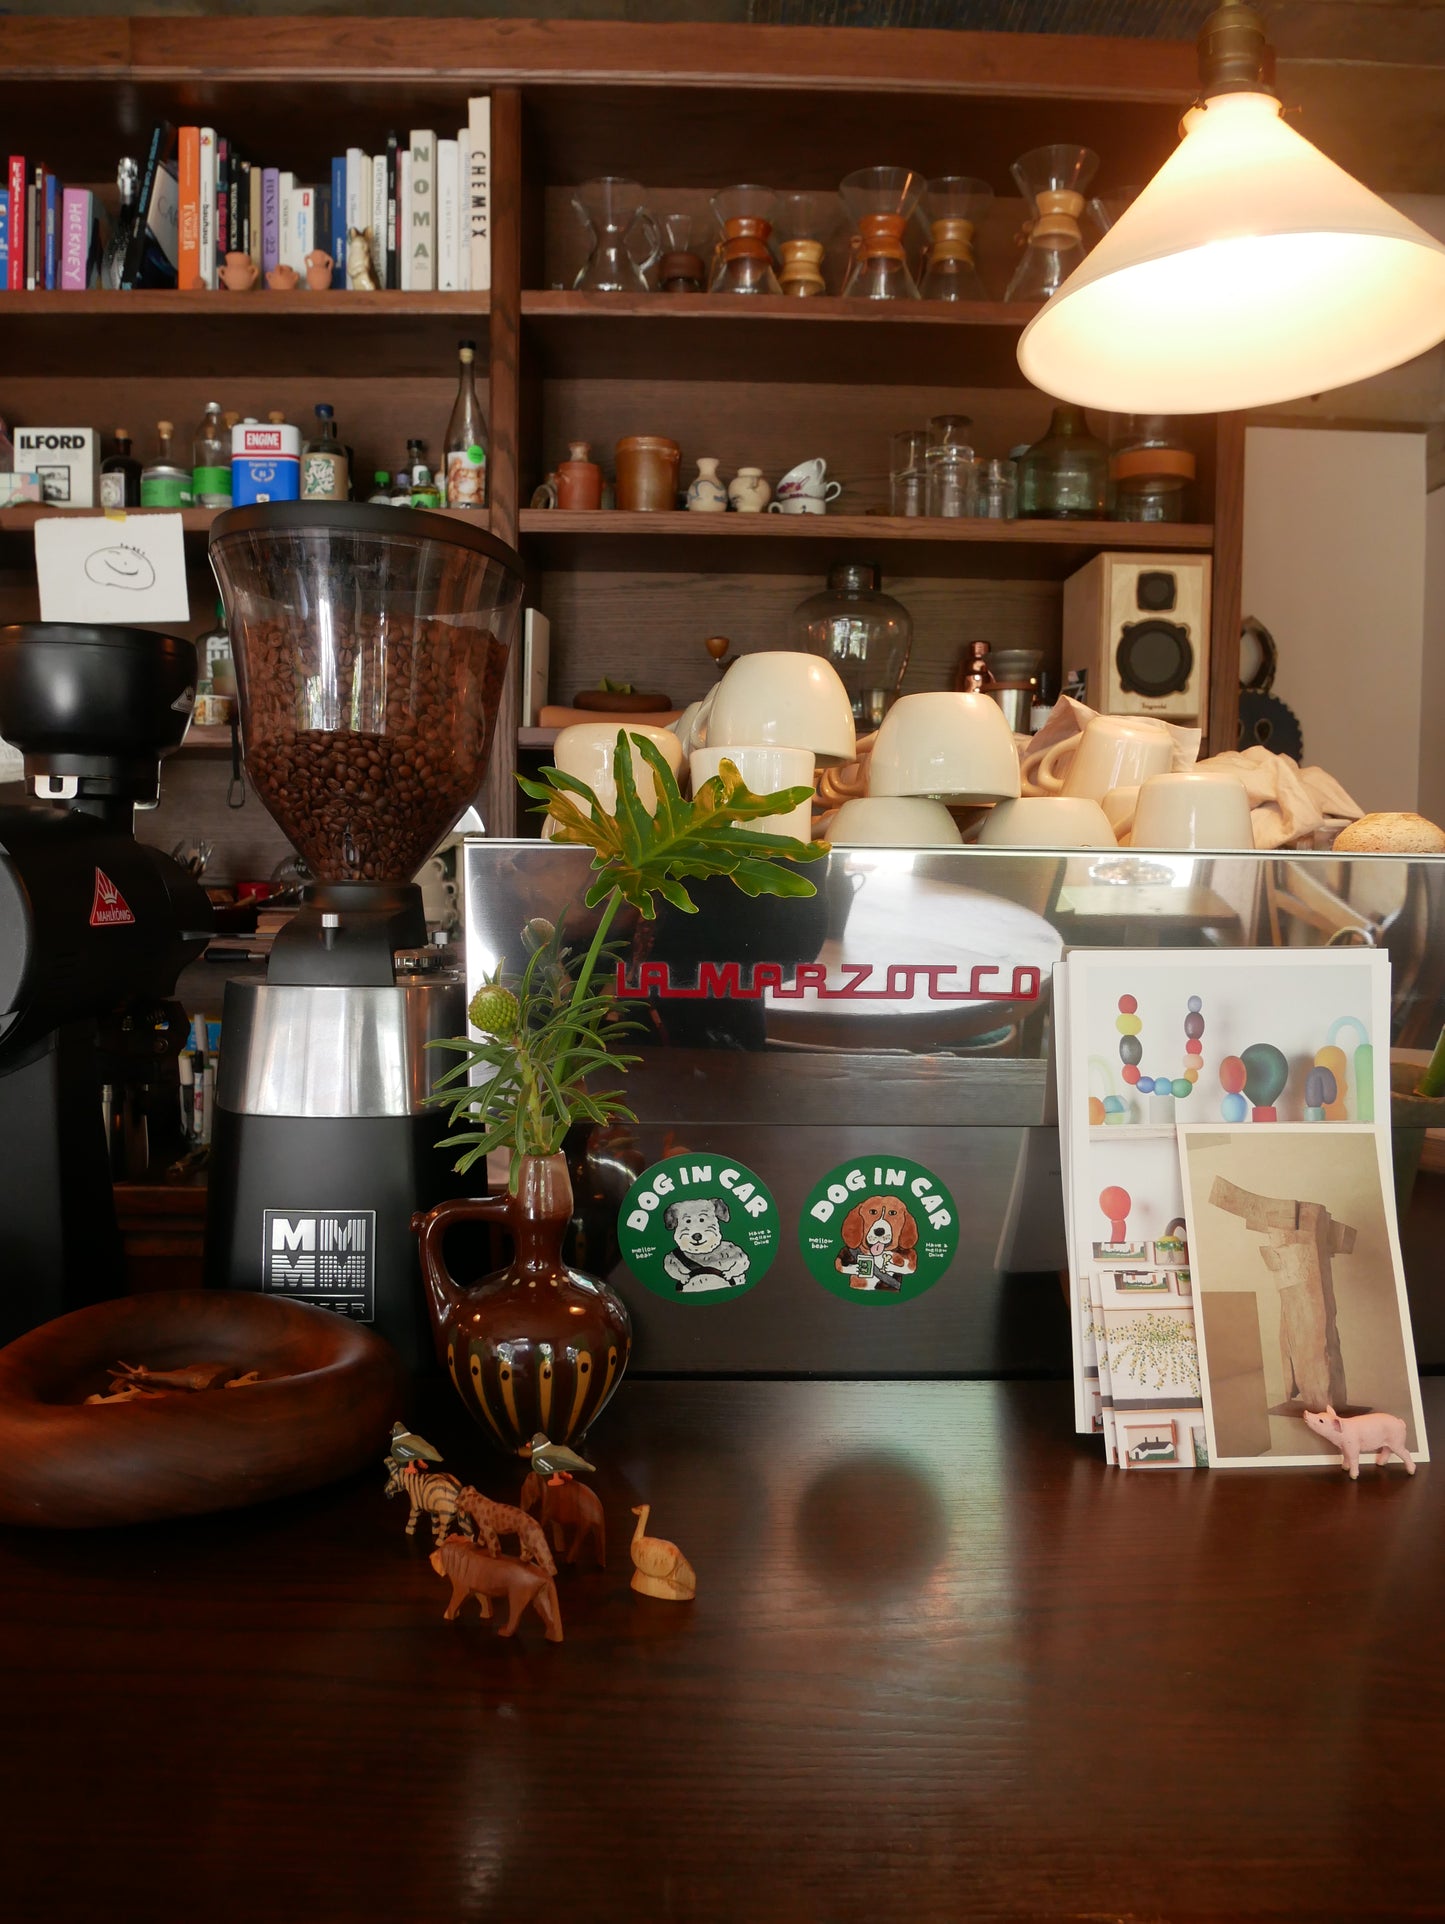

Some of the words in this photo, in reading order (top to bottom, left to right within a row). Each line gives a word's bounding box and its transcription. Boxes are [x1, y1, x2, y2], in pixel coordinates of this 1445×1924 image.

[413, 146, 430, 258] NOMA
[472, 151, 487, 238] CHEMEX
[65, 202, 83, 283] HOCKNEY
[20, 435, 85, 449] ILFORD
[247, 432, 279, 446] ENGINE
[617, 962, 671, 998] LA
[700, 962, 1041, 1000] MARZOCCO
[626, 1173, 676, 1232] DOG
[679, 1165, 712, 1185] IN
[719, 1168, 768, 1218] CAR
[810, 1169, 867, 1223] DOG
[874, 1167, 906, 1186] IN
[910, 1177, 952, 1230] CAR
